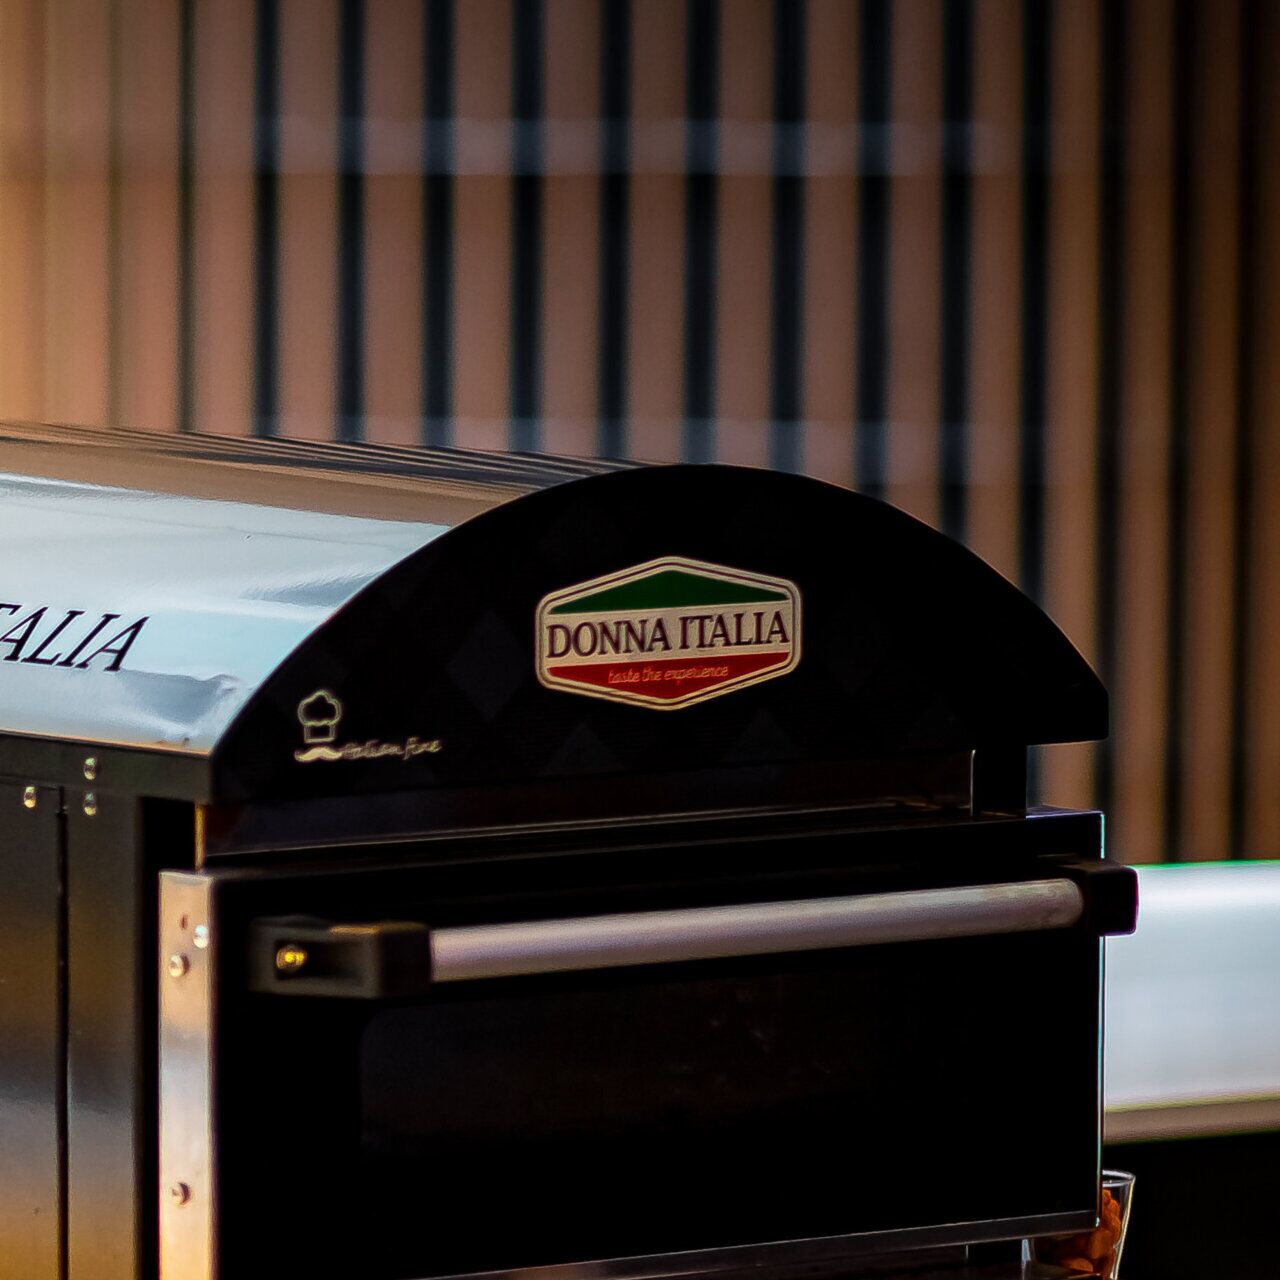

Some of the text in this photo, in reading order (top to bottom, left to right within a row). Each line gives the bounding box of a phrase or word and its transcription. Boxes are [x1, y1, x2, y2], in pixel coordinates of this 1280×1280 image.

[546, 610, 790, 659] DONNA ITALIA
[608, 666, 728, 686] taste the experience
